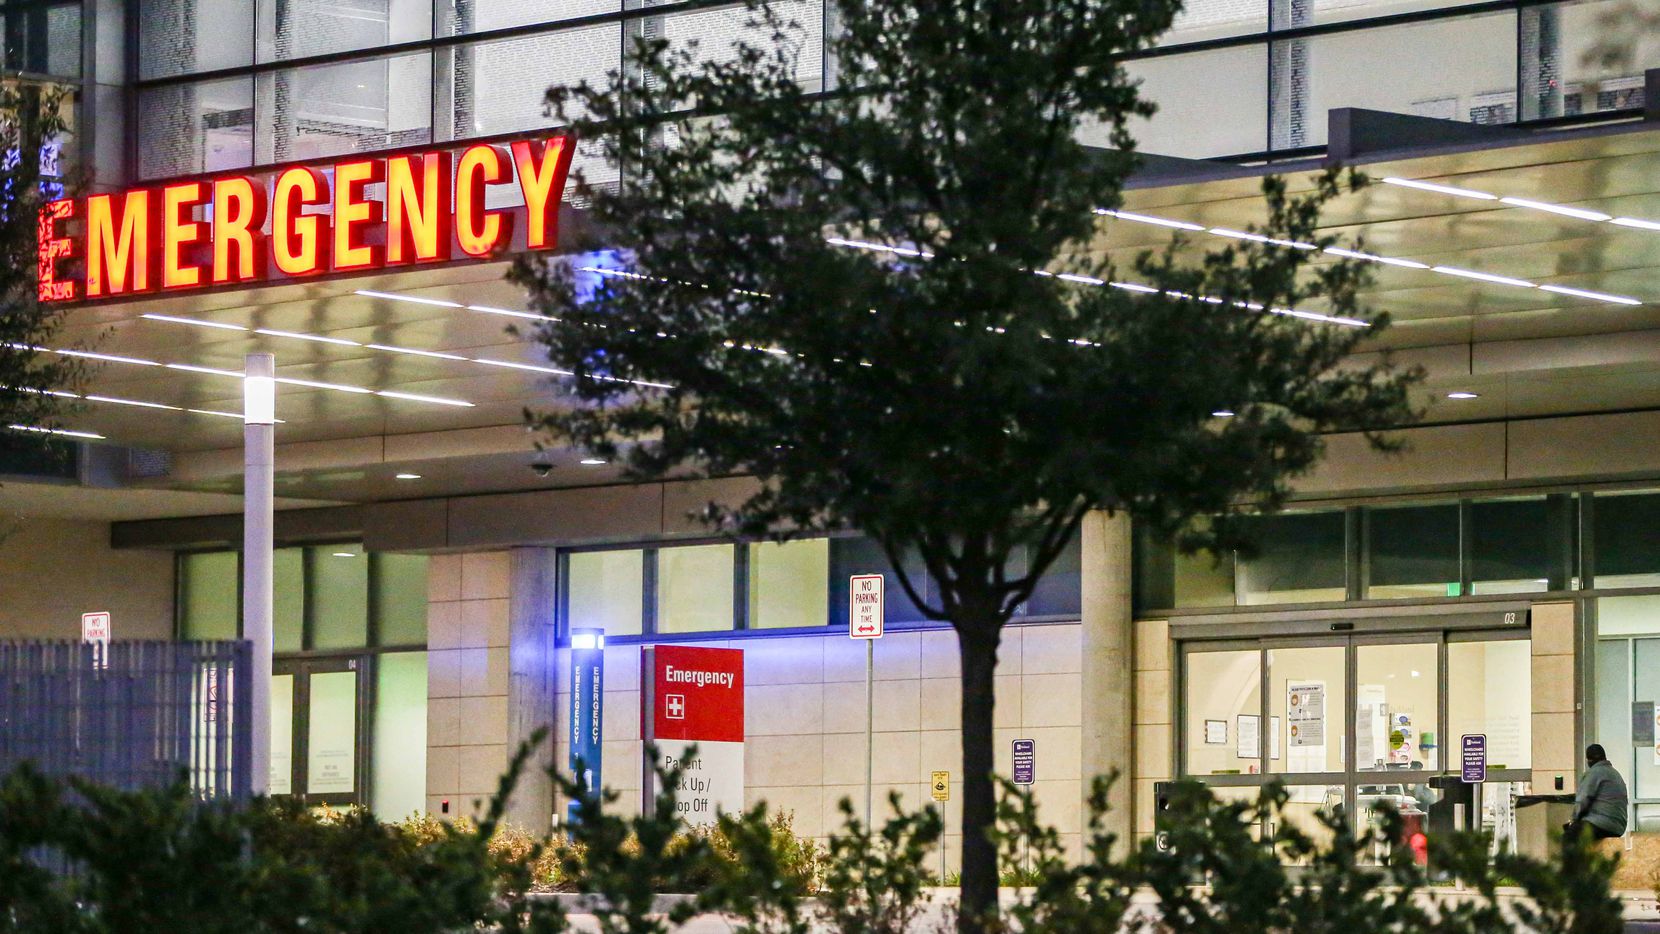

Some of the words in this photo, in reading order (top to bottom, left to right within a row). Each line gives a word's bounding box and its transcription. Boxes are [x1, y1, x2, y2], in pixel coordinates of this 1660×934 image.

[38, 135, 570, 302] EMERGENCY
[862, 581, 872, 591] NO
[856, 593, 878, 604] PARKING
[861, 605, 872, 613] ANY
[92, 618, 100, 627] NO
[861, 615, 872, 623] TIME
[1504, 613, 1516, 624] 03
[349, 660, 356, 669] 04
[665, 665, 734, 688] Emergency
[592, 666, 600, 745] EMERGENCY
[665, 755, 702, 770] Paent
[690, 777, 705, 794] Up
[693, 798, 708, 812] Off
